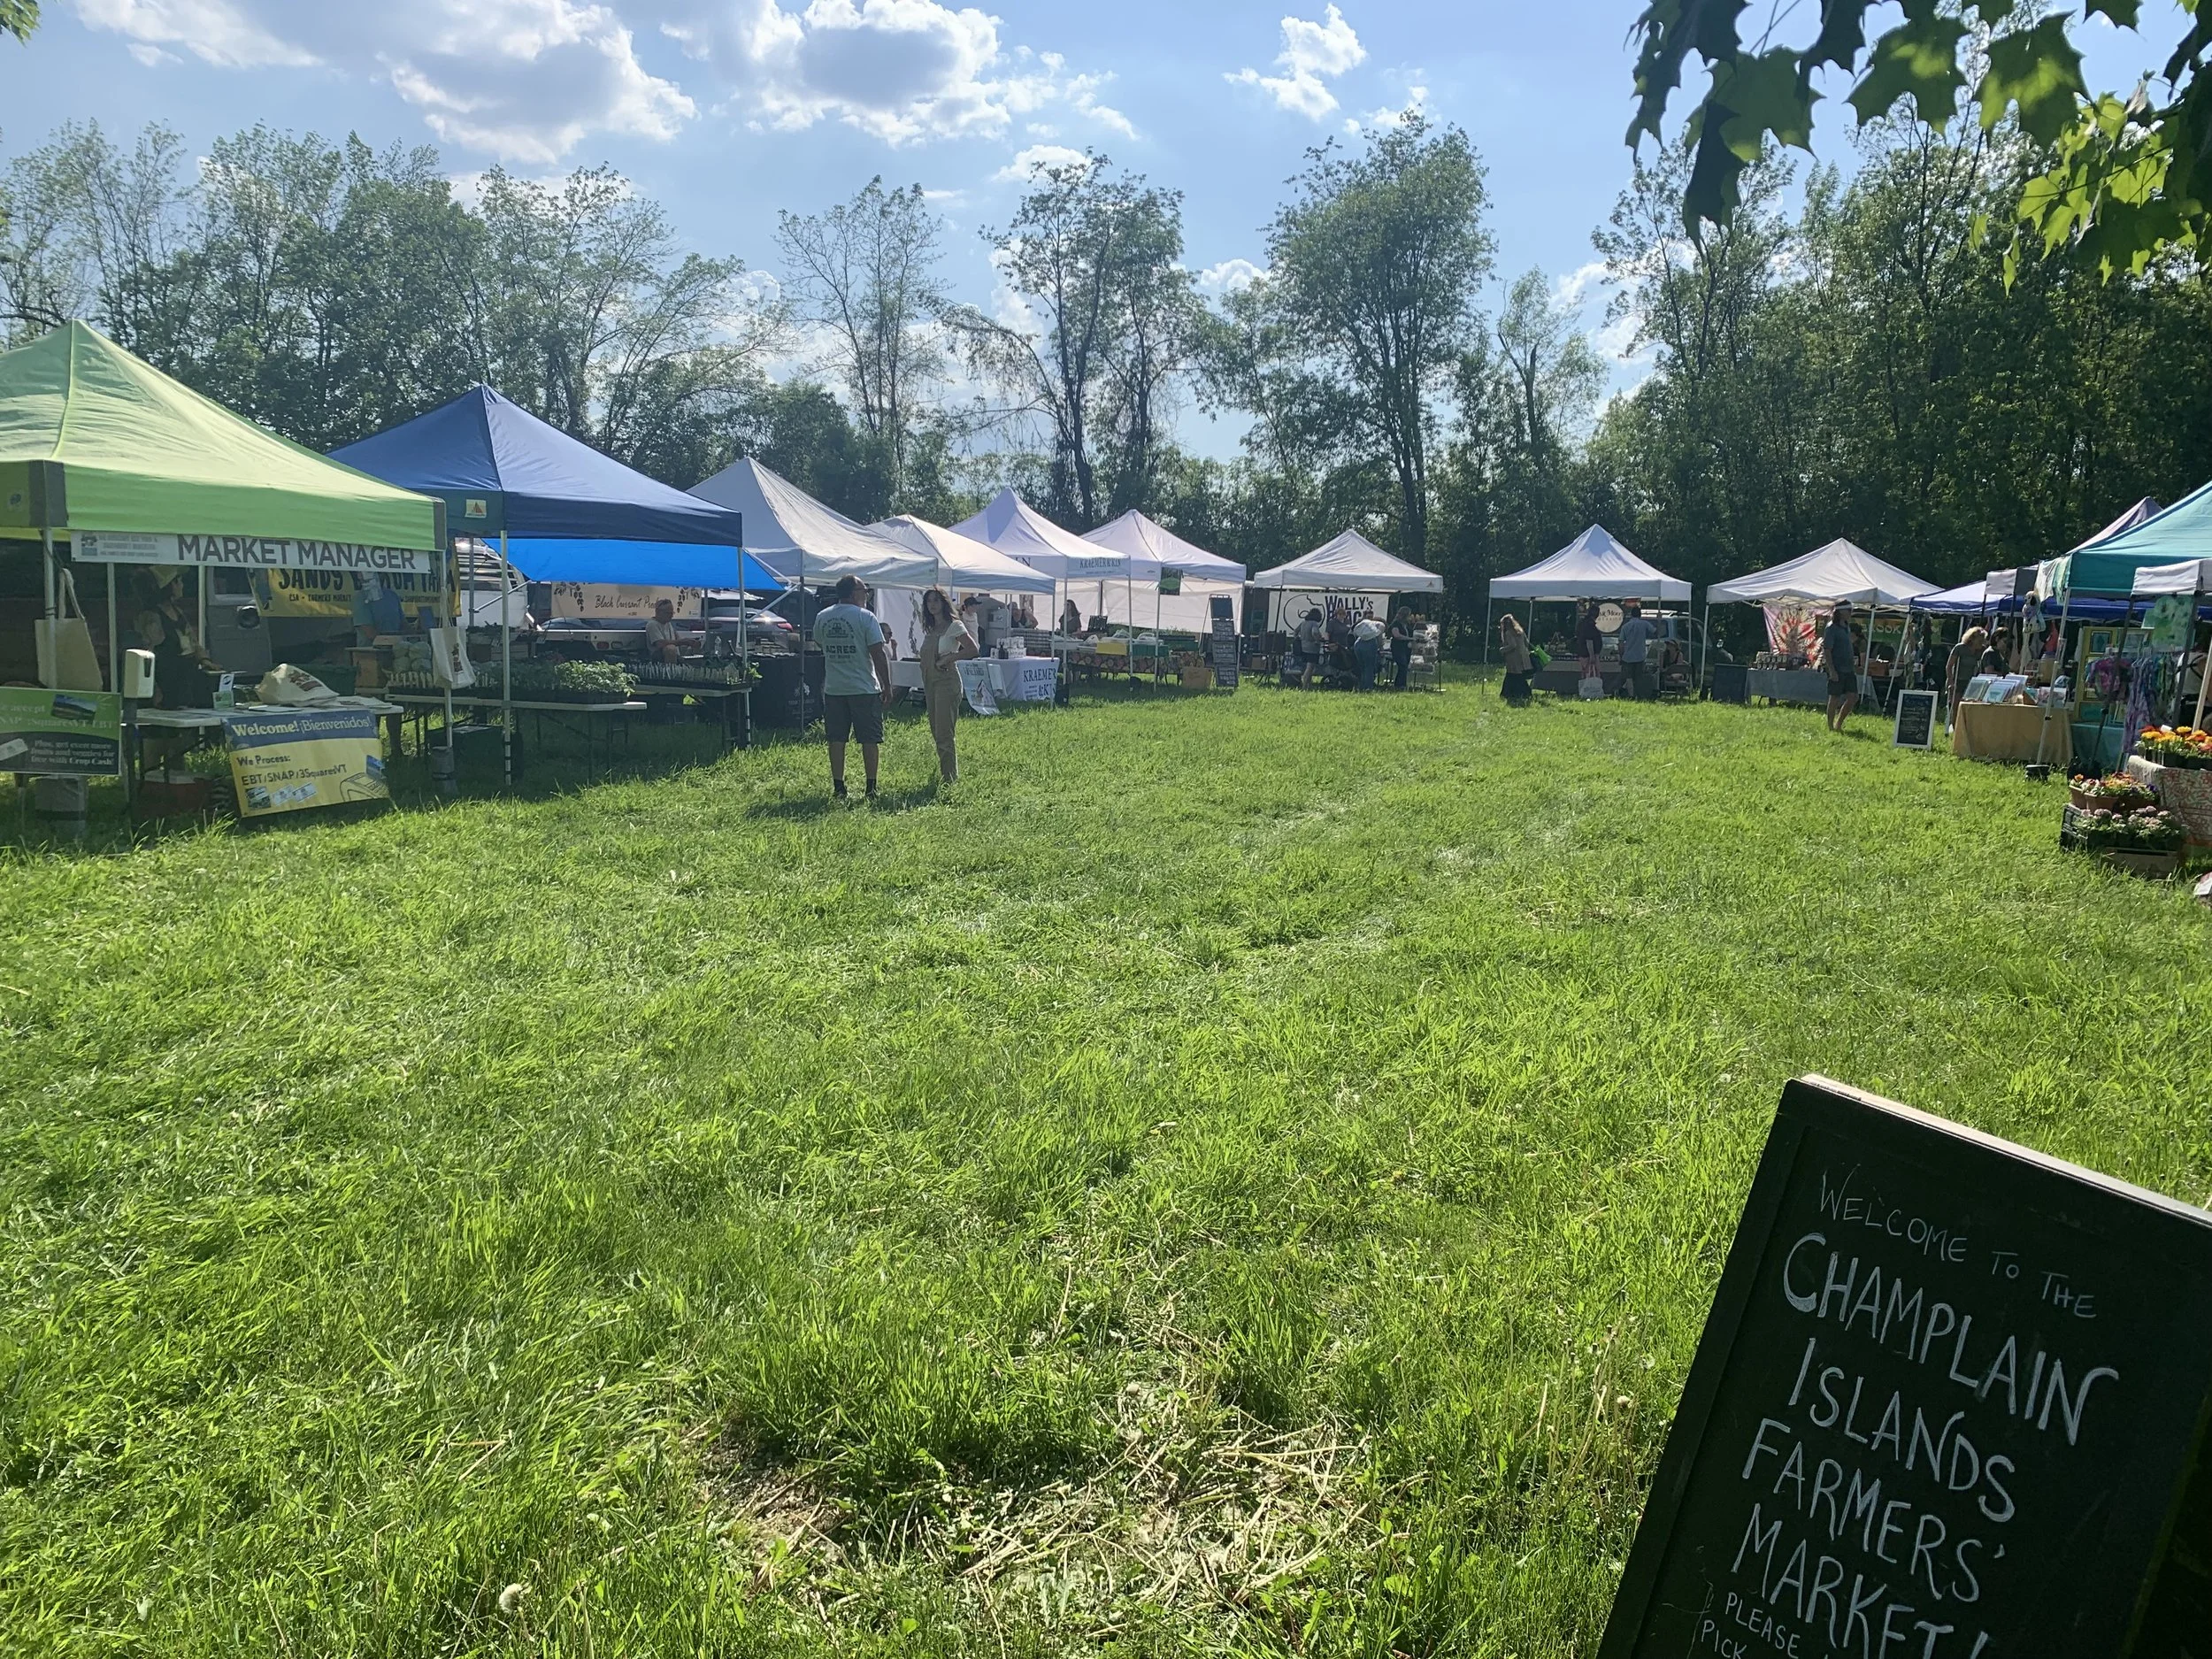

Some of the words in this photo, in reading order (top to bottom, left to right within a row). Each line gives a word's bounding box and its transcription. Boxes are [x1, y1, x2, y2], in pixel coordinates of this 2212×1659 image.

[178, 534, 290, 565] MARKET
[297, 541, 416, 570] MANAGER
[595, 595, 613, 609] Black
[615, 595, 642, 609] Currant
[1325, 595, 1374, 611] WALLY's
[232, 720, 300, 737] Welcome!
[300, 716, 373, 733] ¡Bienvenidos!
[237, 757, 253, 766] We
[255, 755, 291, 765] Process:
[1820, 1164, 1968, 1262] WELCOME
[2040, 1270, 2097, 1319] THE
[1783, 1233, 2118, 1446] CHAMPLAIN
[1788, 1337, 2016, 1522] ISLANDS
[1742, 1417, 2005, 1601] FARMERS'
[1701, 1619, 1748, 1659] PICK
[1725, 1592, 1801, 1659] PLEASE
